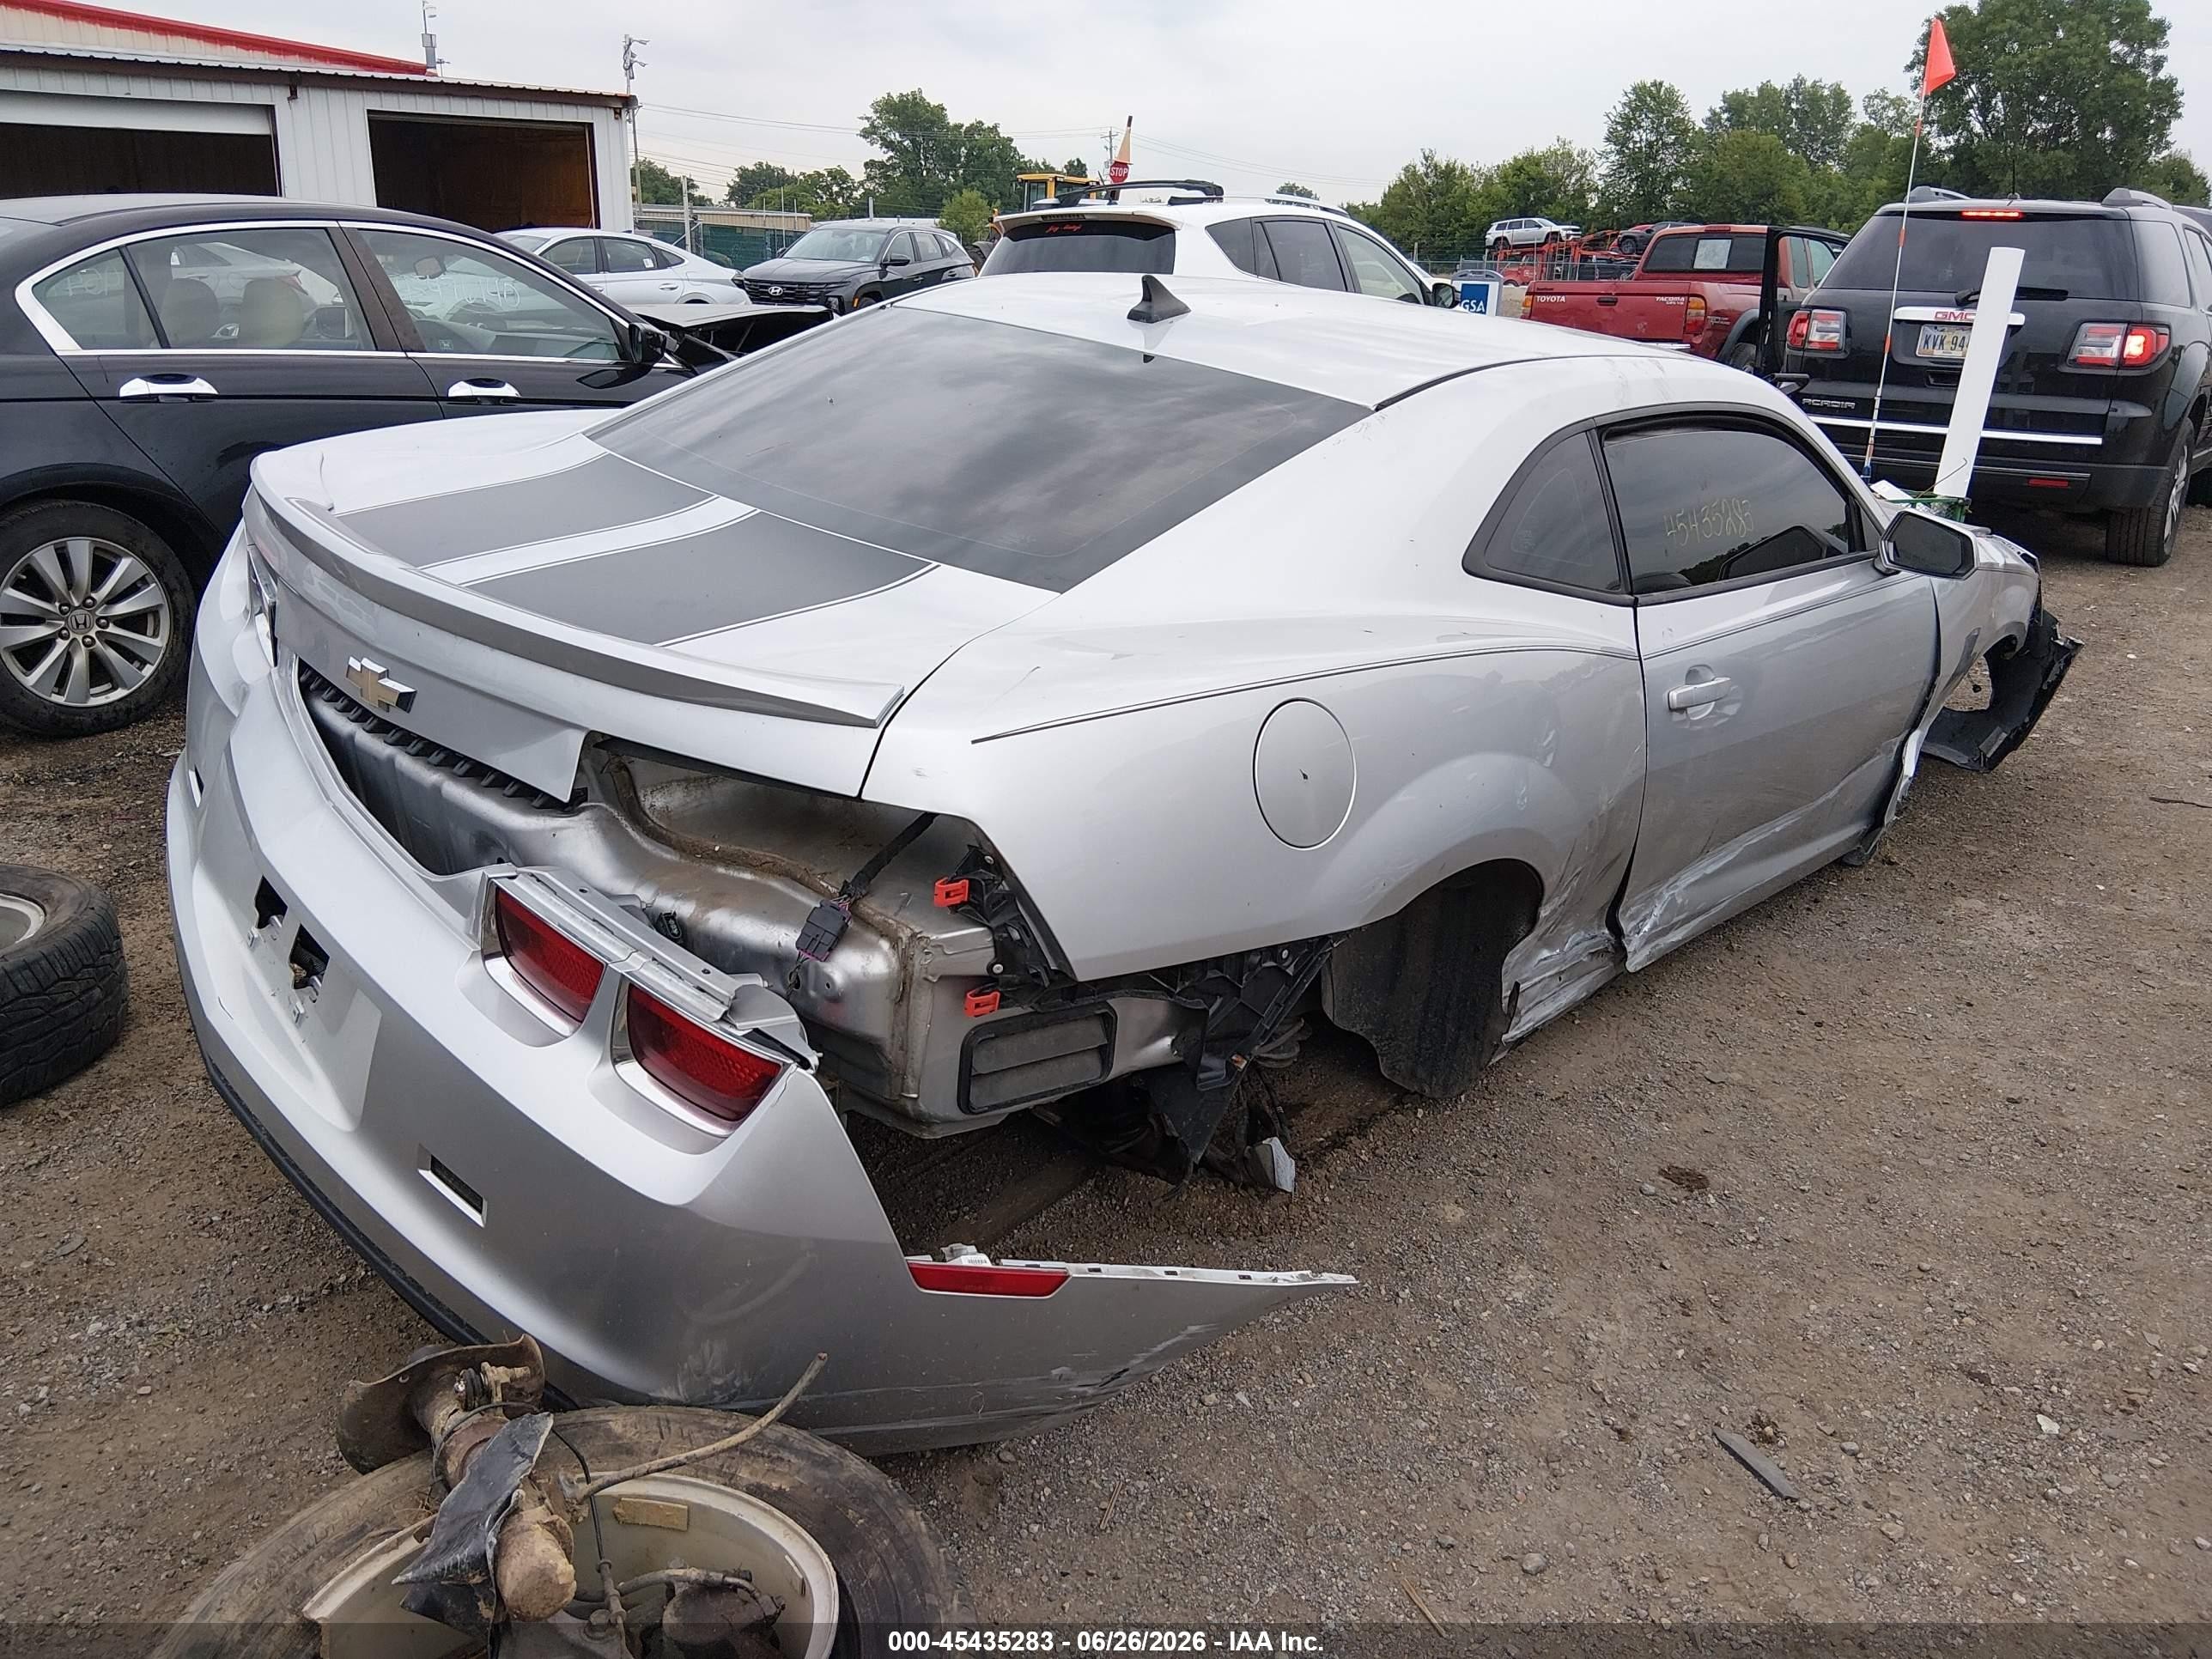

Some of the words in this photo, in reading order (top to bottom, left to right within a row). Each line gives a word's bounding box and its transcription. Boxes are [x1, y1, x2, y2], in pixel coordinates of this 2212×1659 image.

[1110, 167, 1128, 177] STOP
[1536, 295, 1566, 303] TOYOTA
[1461, 299, 1486, 313] GSA
[1935, 311, 1976, 322] GMC
[1923, 333, 1947, 351] KVK
[1950, 335, 1970, 352] 94
[1802, 398, 1856, 410] ACADIA
[1663, 497, 1754, 547] 45435283
